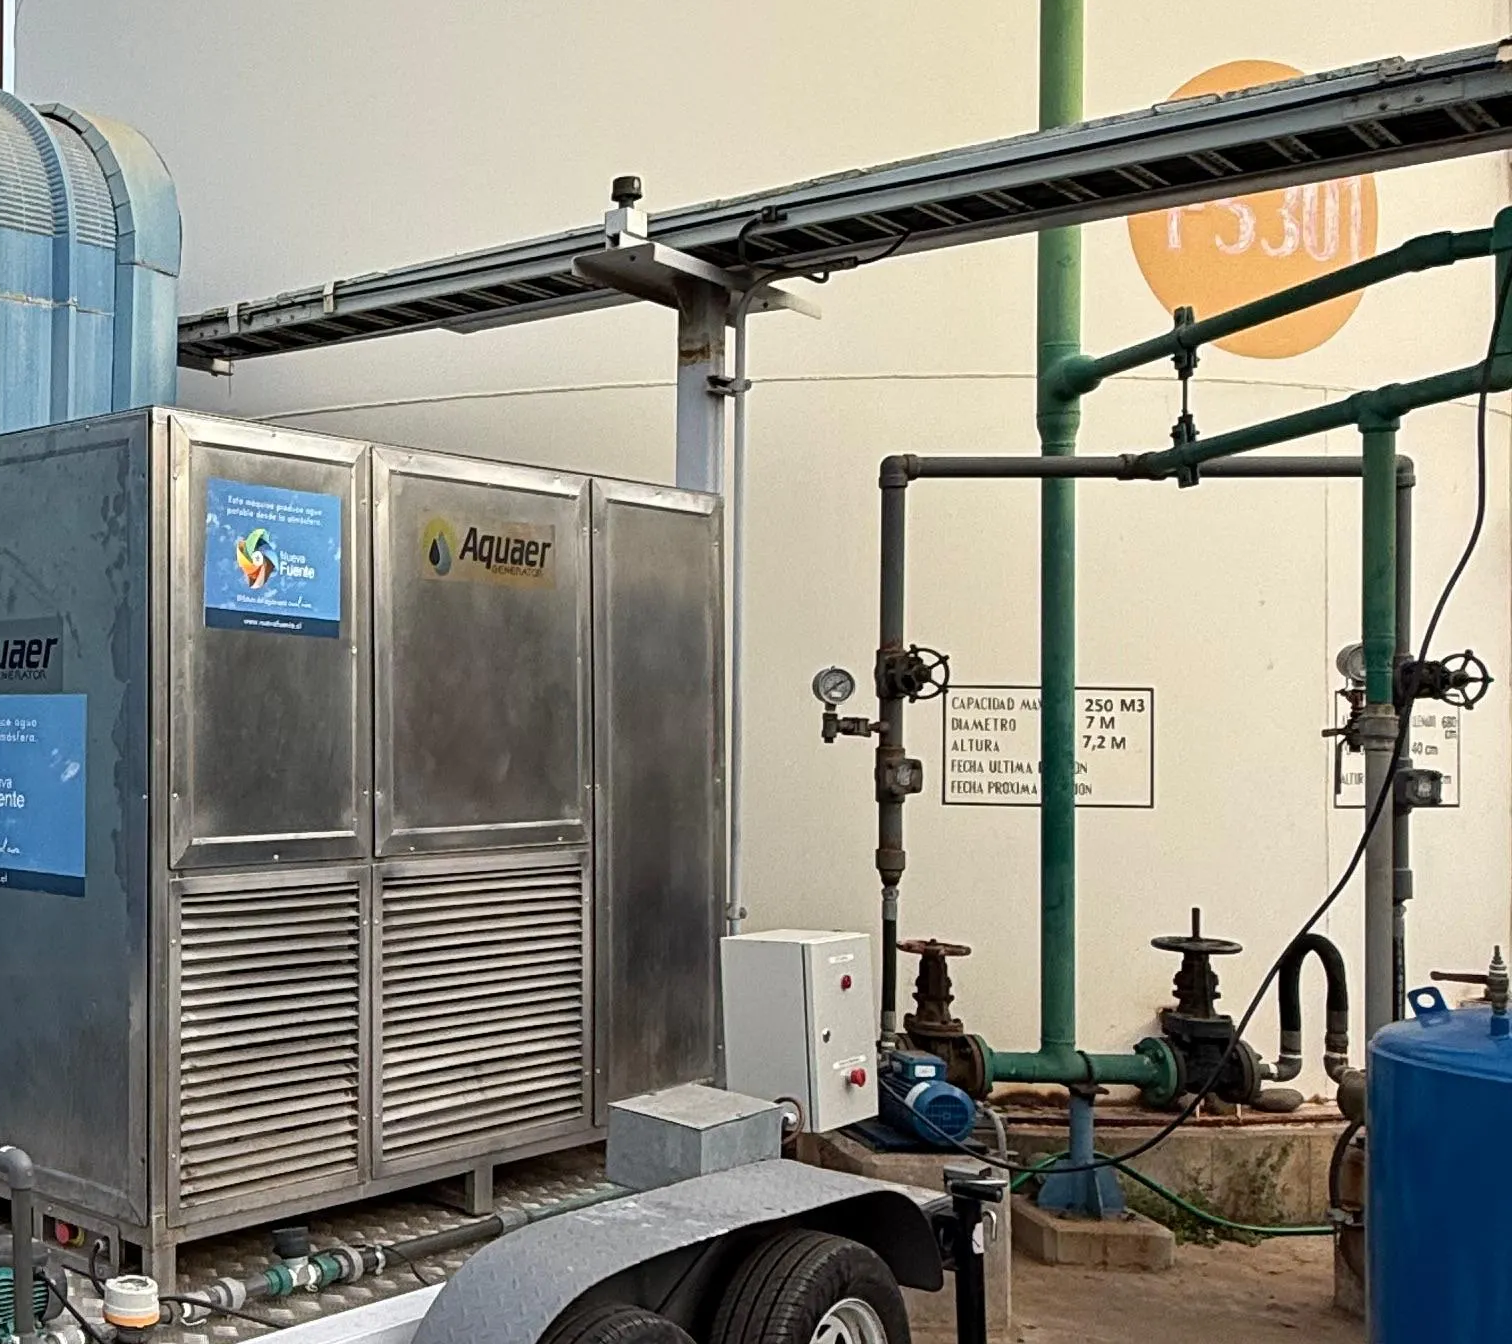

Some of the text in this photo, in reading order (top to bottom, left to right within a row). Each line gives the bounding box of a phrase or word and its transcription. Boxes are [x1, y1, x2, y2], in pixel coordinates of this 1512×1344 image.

[459, 527, 552, 569] Aquaer
[280, 561, 315, 579] Fuente
[951, 697, 1015, 711] CAPACIDAD
[1085, 698, 1114, 712] 250
[1120, 698, 1145, 712] M3
[951, 715, 1115, 731] DIAMETRO 7 M
[951, 735, 1126, 752] ALTURA 7,2 M
[951, 759, 983, 773] FECHA
[989, 760, 1033, 774] ULTIMA
[951, 781, 1038, 795] FECHA PROXIMA
